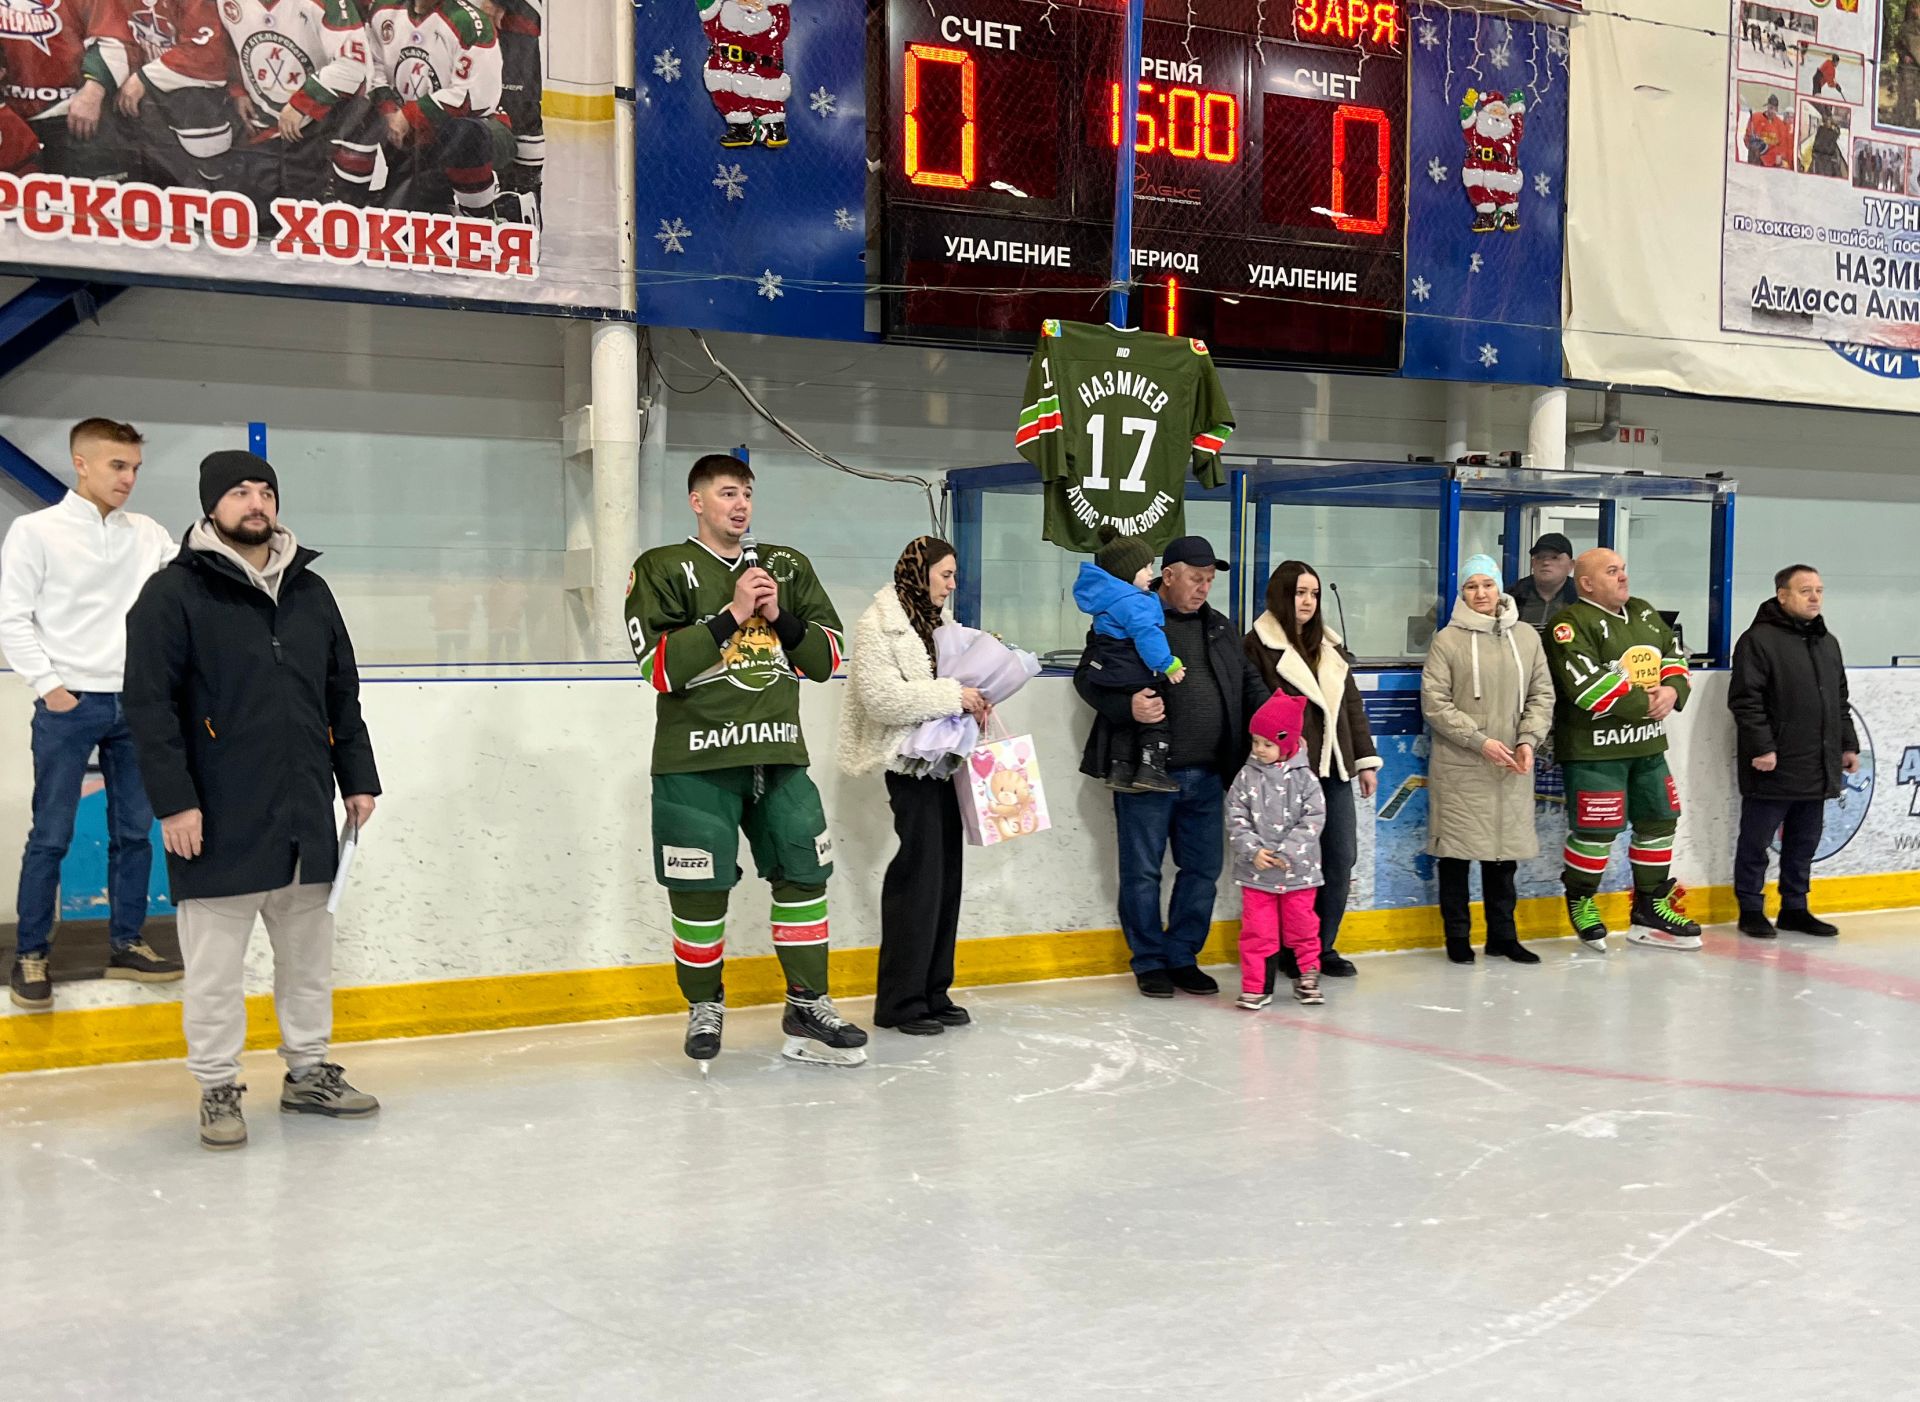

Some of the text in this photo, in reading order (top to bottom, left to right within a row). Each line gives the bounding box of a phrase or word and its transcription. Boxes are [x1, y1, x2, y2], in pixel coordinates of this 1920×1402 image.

[941, 15, 1022, 50] СЧЕТ
[1299, 0, 1395, 43] ЗАРЯ
[1140, 57, 1202, 84] РЕМЯ
[1294, 68, 1361, 100] СЧЕТ
[905, 44, 974, 189] 0
[1332, 104, 1390, 235] 0
[277, 204, 533, 275] ХОККЕЯ
[944, 236, 1071, 267] УДАЛЕНИЕ
[1735, 215, 1752, 231] по
[1756, 219, 1814, 240] хоккею
[1816, 227, 1826, 241] с
[1829, 229, 1888, 253] шайбой,
[1248, 264, 1358, 292] УДАЛЕНИЕ
[1753, 275, 1857, 316] Атласа
[1078, 371, 1169, 413] НАЗМИЕВ
[1083, 414, 1157, 492] 17
[1066, 485, 1100, 529] АТЛАС
[681, 561, 699, 589] К
[628, 616, 646, 655] 9
[1566, 654, 1599, 686] 11
